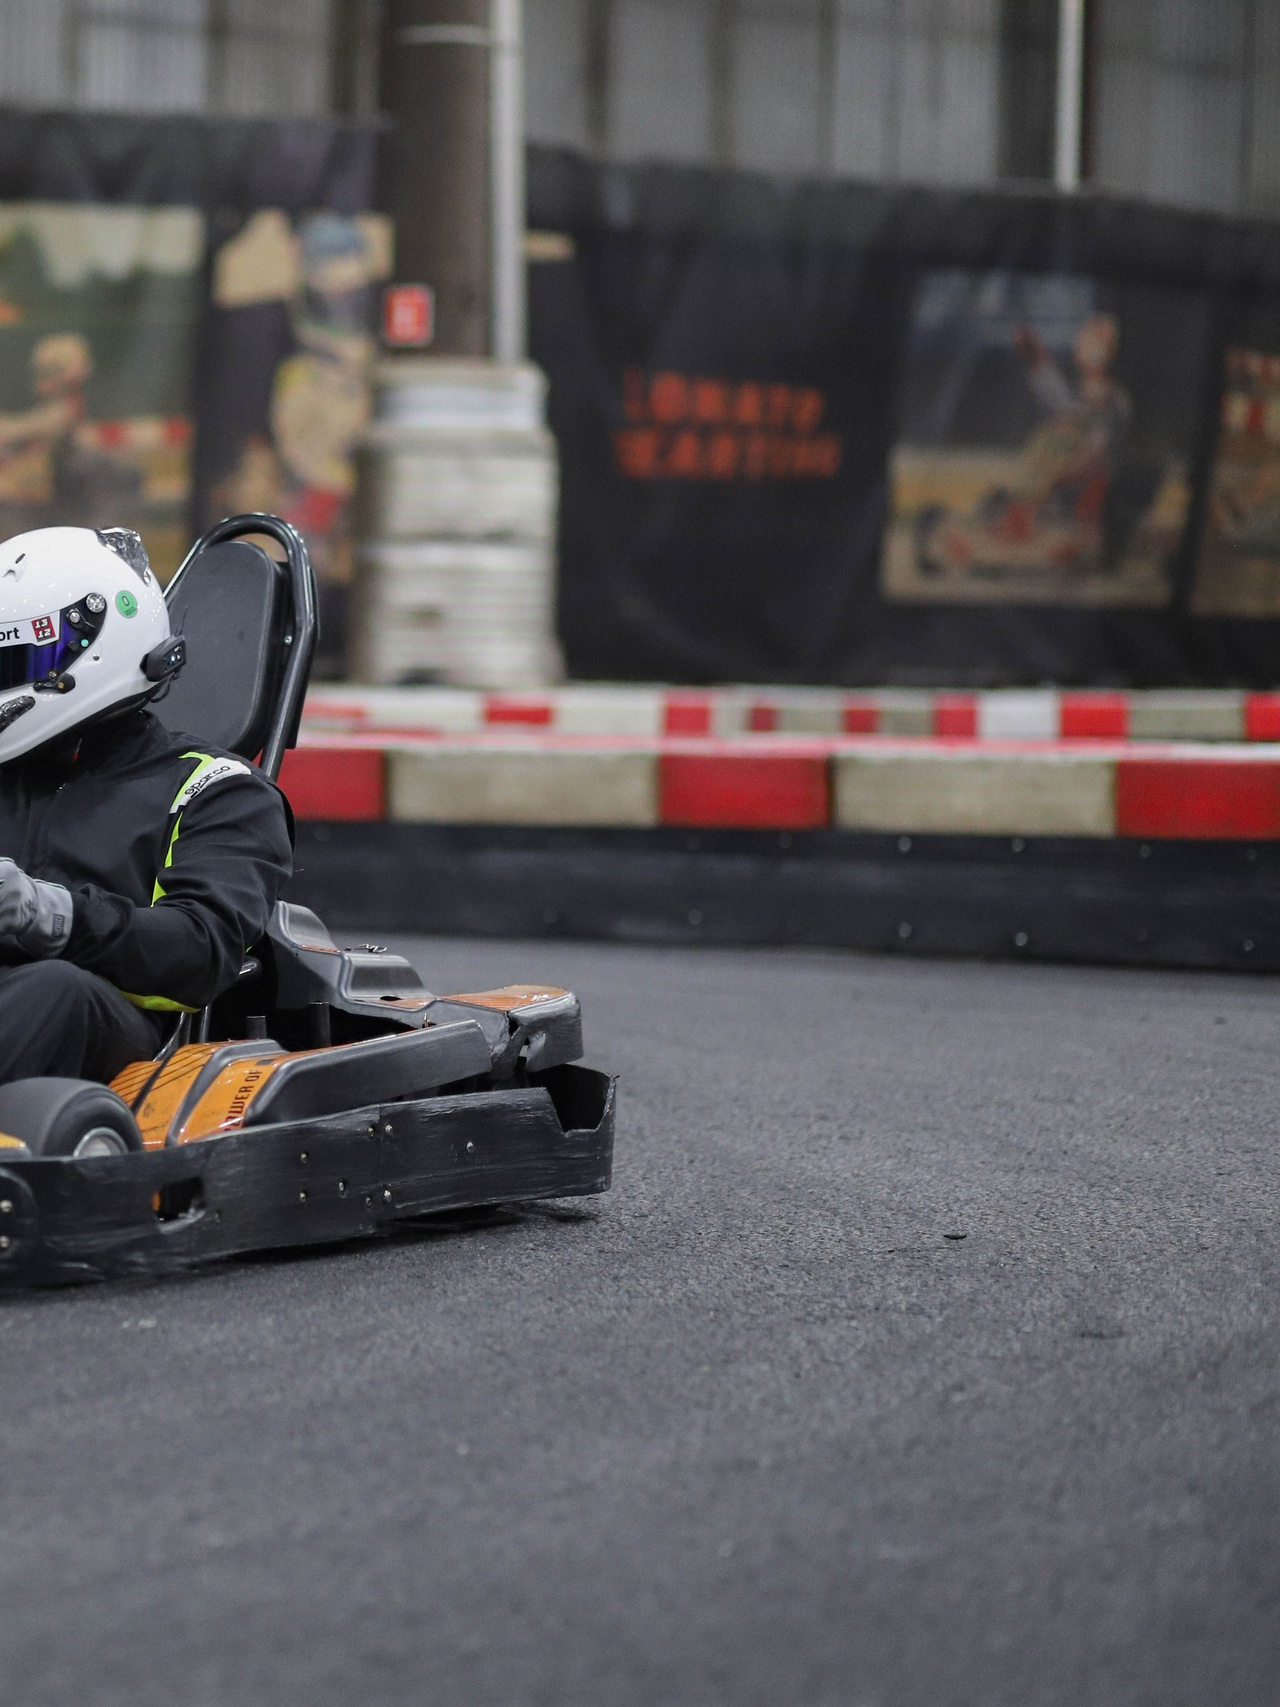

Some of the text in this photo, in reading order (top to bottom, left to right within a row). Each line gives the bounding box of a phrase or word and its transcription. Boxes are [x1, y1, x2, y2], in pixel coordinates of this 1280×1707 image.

[35, 619, 48, 629] 13
[38, 629, 51, 639] 12
[185, 766, 230, 797] sparco
[224, 1086, 254, 1131] OWER
